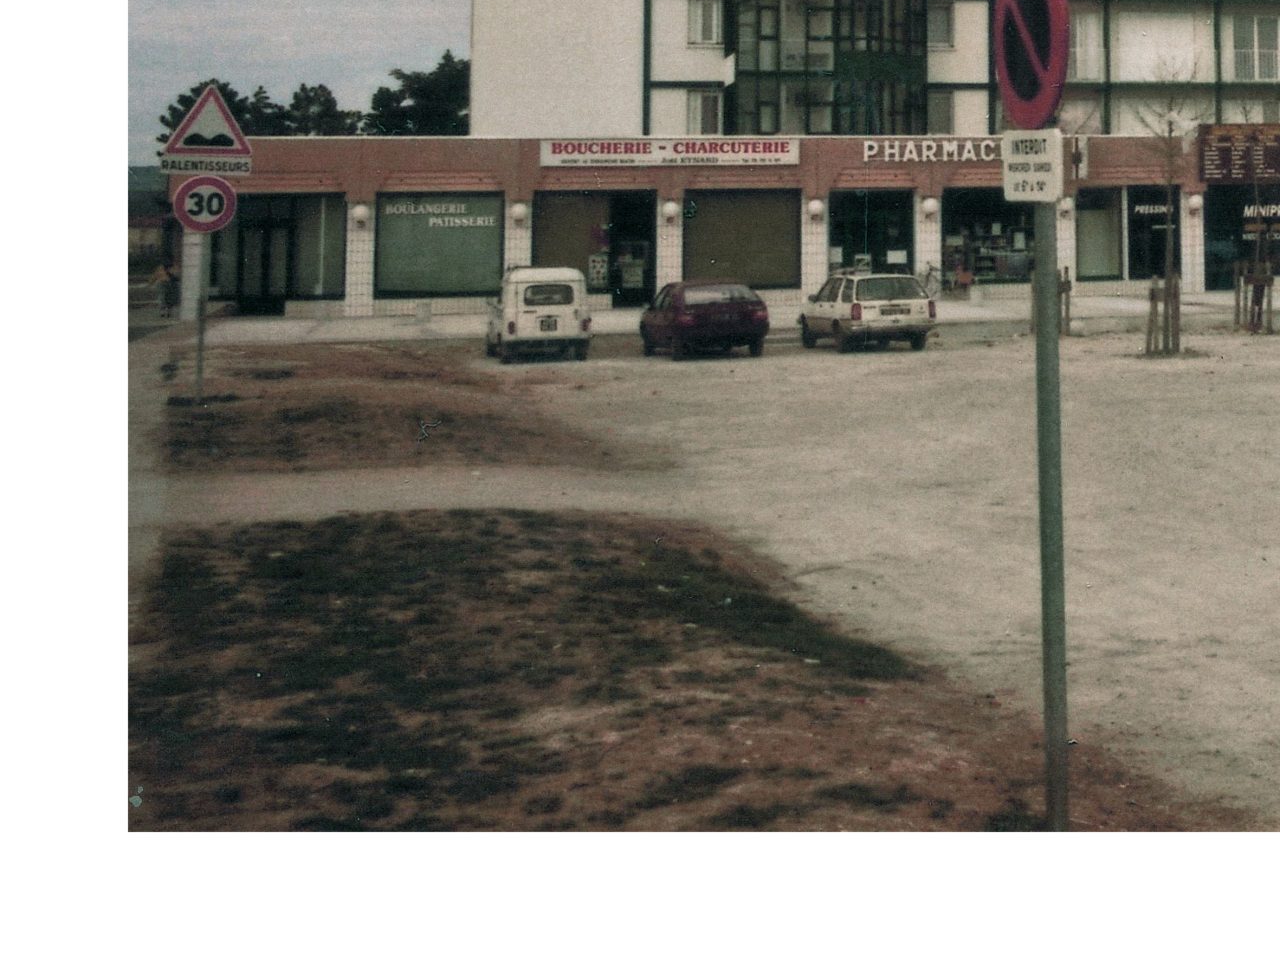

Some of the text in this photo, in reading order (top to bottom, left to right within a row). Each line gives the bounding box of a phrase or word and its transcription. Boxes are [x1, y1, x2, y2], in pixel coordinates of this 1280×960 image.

[551, 142, 652, 155] BOUCHERIE
[673, 141, 790, 154] CHARCUTERIE
[863, 140, 996, 162] PHARMAC
[1011, 138, 1047, 155] INTERDIT
[161, 160, 250, 172] RALENTISSEURS
[187, 192, 225, 216] 30
[385, 203, 467, 215] BOULANGERIE
[428, 216, 496, 228] PATISSERIE
